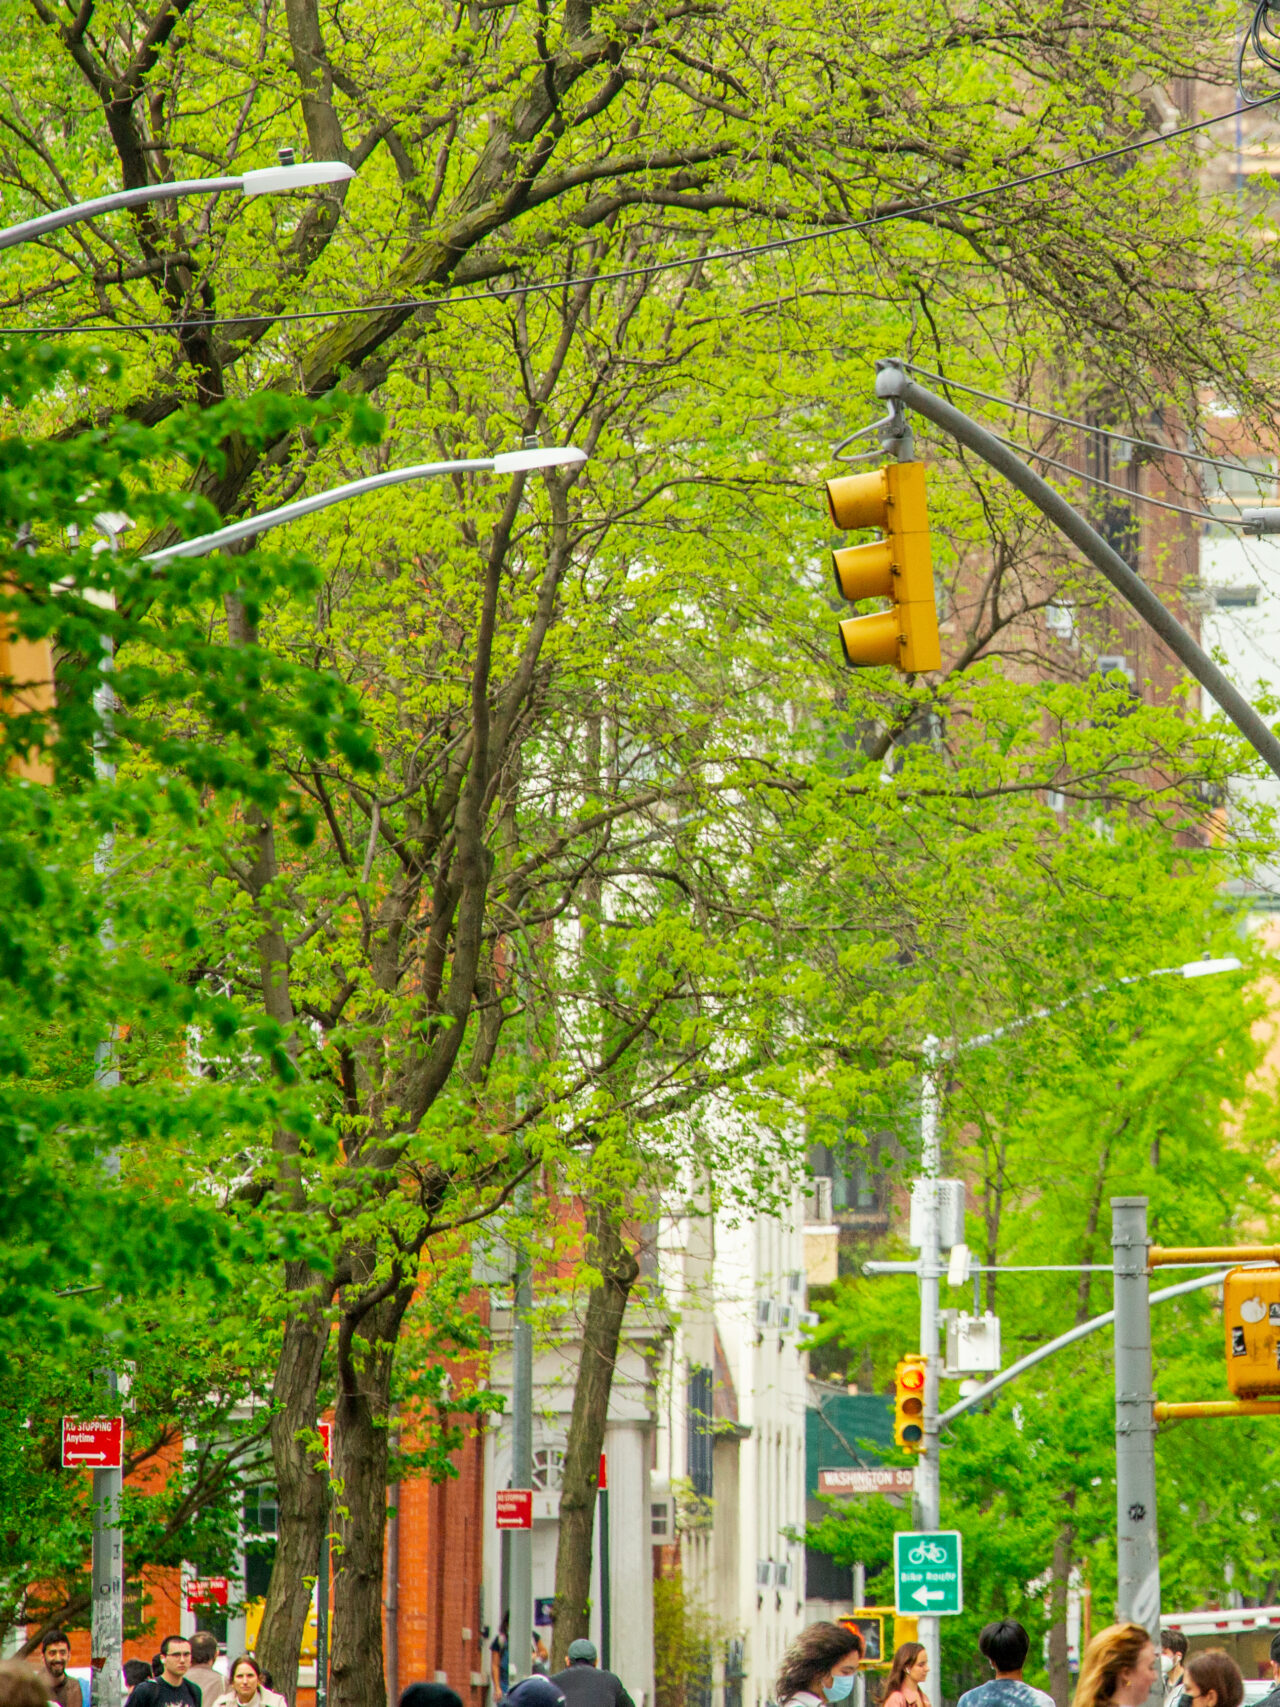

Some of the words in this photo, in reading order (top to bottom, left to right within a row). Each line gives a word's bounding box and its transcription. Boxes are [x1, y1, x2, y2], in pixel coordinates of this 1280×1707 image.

[77, 1421, 112, 1432] STOPPING
[65, 1433, 95, 1445] Anytime
[824, 1471, 893, 1486] WASHINGTON
[900, 1571, 923, 1583] Bike
[926, 1571, 957, 1582] Route
